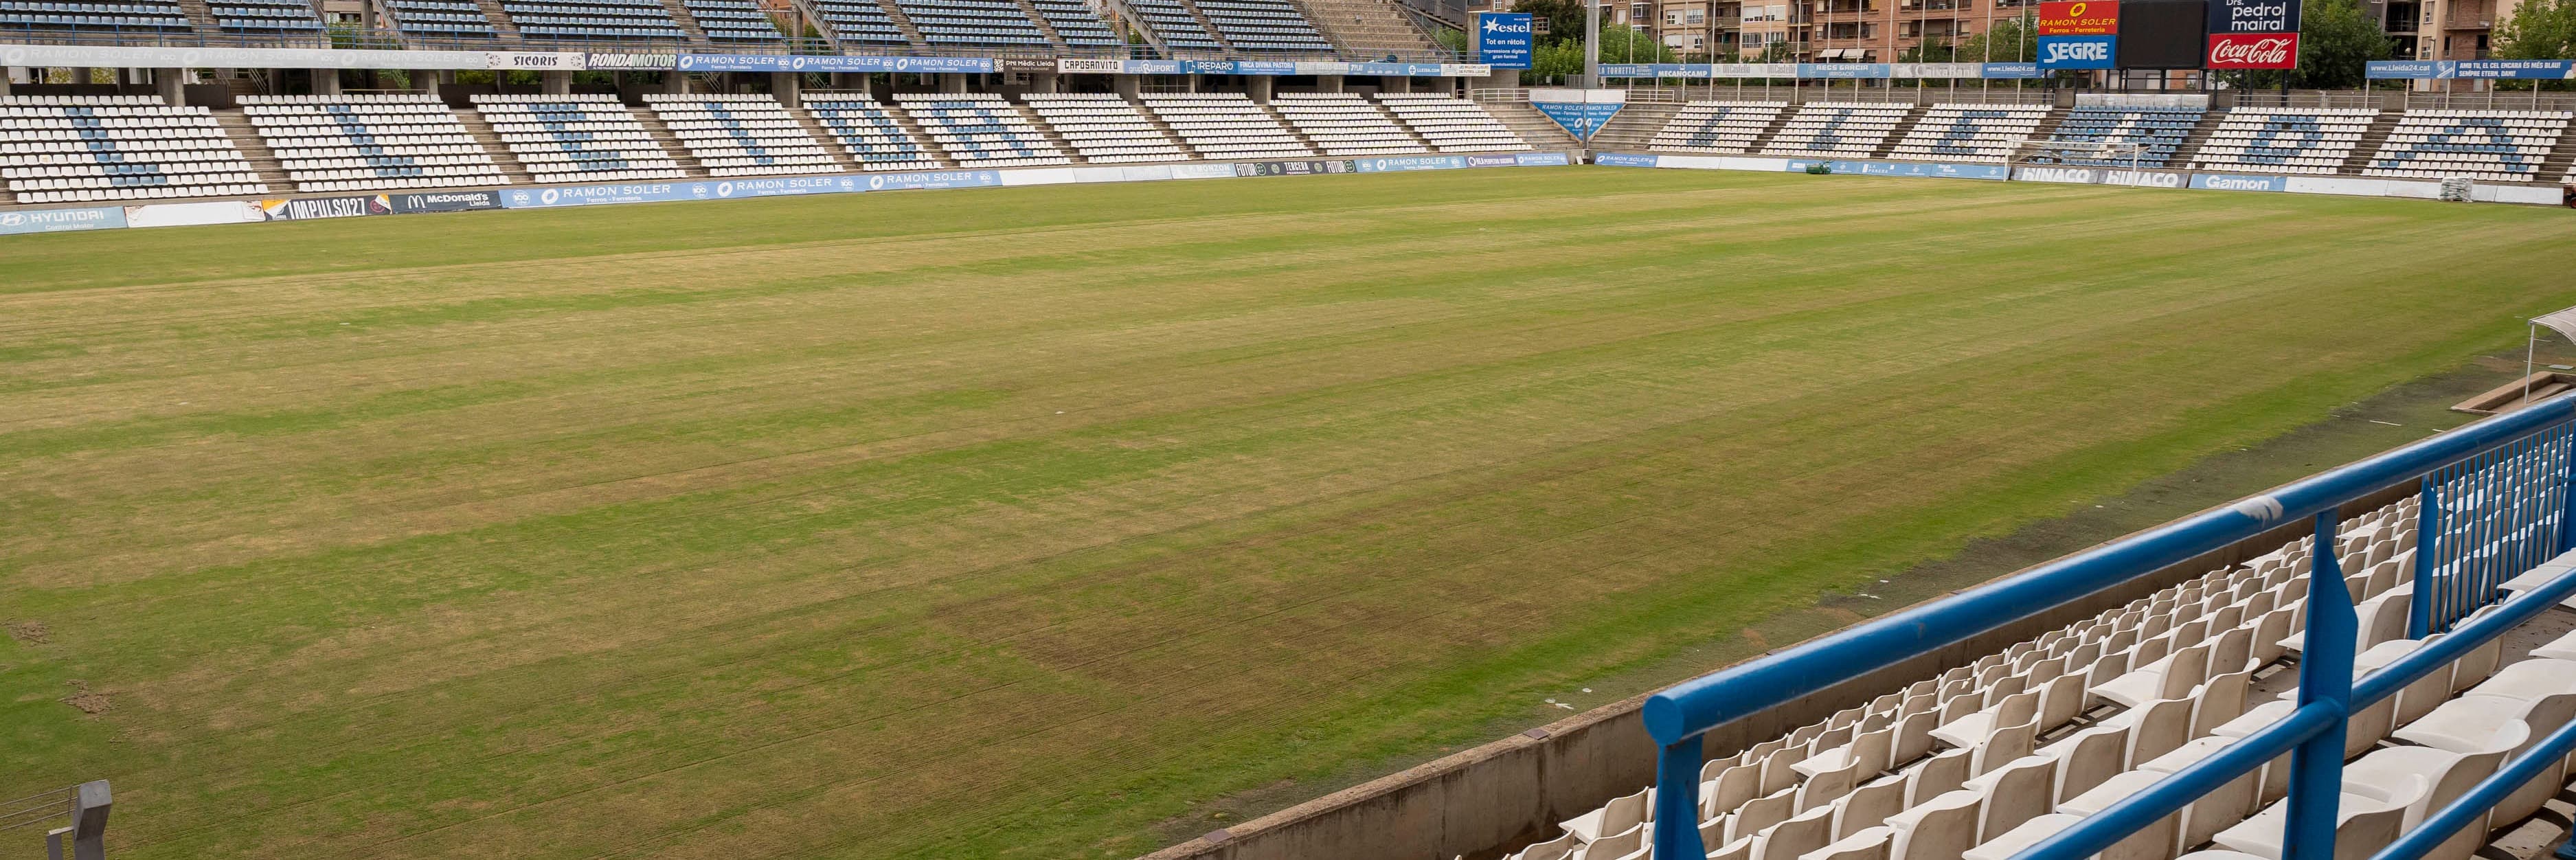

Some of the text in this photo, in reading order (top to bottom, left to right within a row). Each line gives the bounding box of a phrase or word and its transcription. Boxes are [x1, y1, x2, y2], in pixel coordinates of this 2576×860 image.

[2232, 2, 2286, 20] pedrol
[1498, 21, 1530, 32] estel
[2231, 17, 2285, 31] mairal
[2044, 43, 2108, 63] SEGRE
[2211, 38, 2293, 64] Coca-Cola
[514, 56, 558, 66] SICORIS
[587, 54, 677, 67] RONDAMOTOR
[1607, 67, 1636, 75] TORRETTA
[1915, 65, 1977, 77] CaixaBank
[736, 179, 784, 190] RAMON
[790, 178, 832, 188] SOLER
[887, 174, 929, 183] RAMON
[934, 172, 971, 181] SOLER
[2206, 175, 2270, 190] Gamon
[427, 193, 489, 203] McDonald's
[563, 186, 617, 198] RAMON
[623, 185, 671, 195] SOLER
[288, 198, 366, 220] IMPULSO27
[30, 210, 105, 223] HYUNDAI
